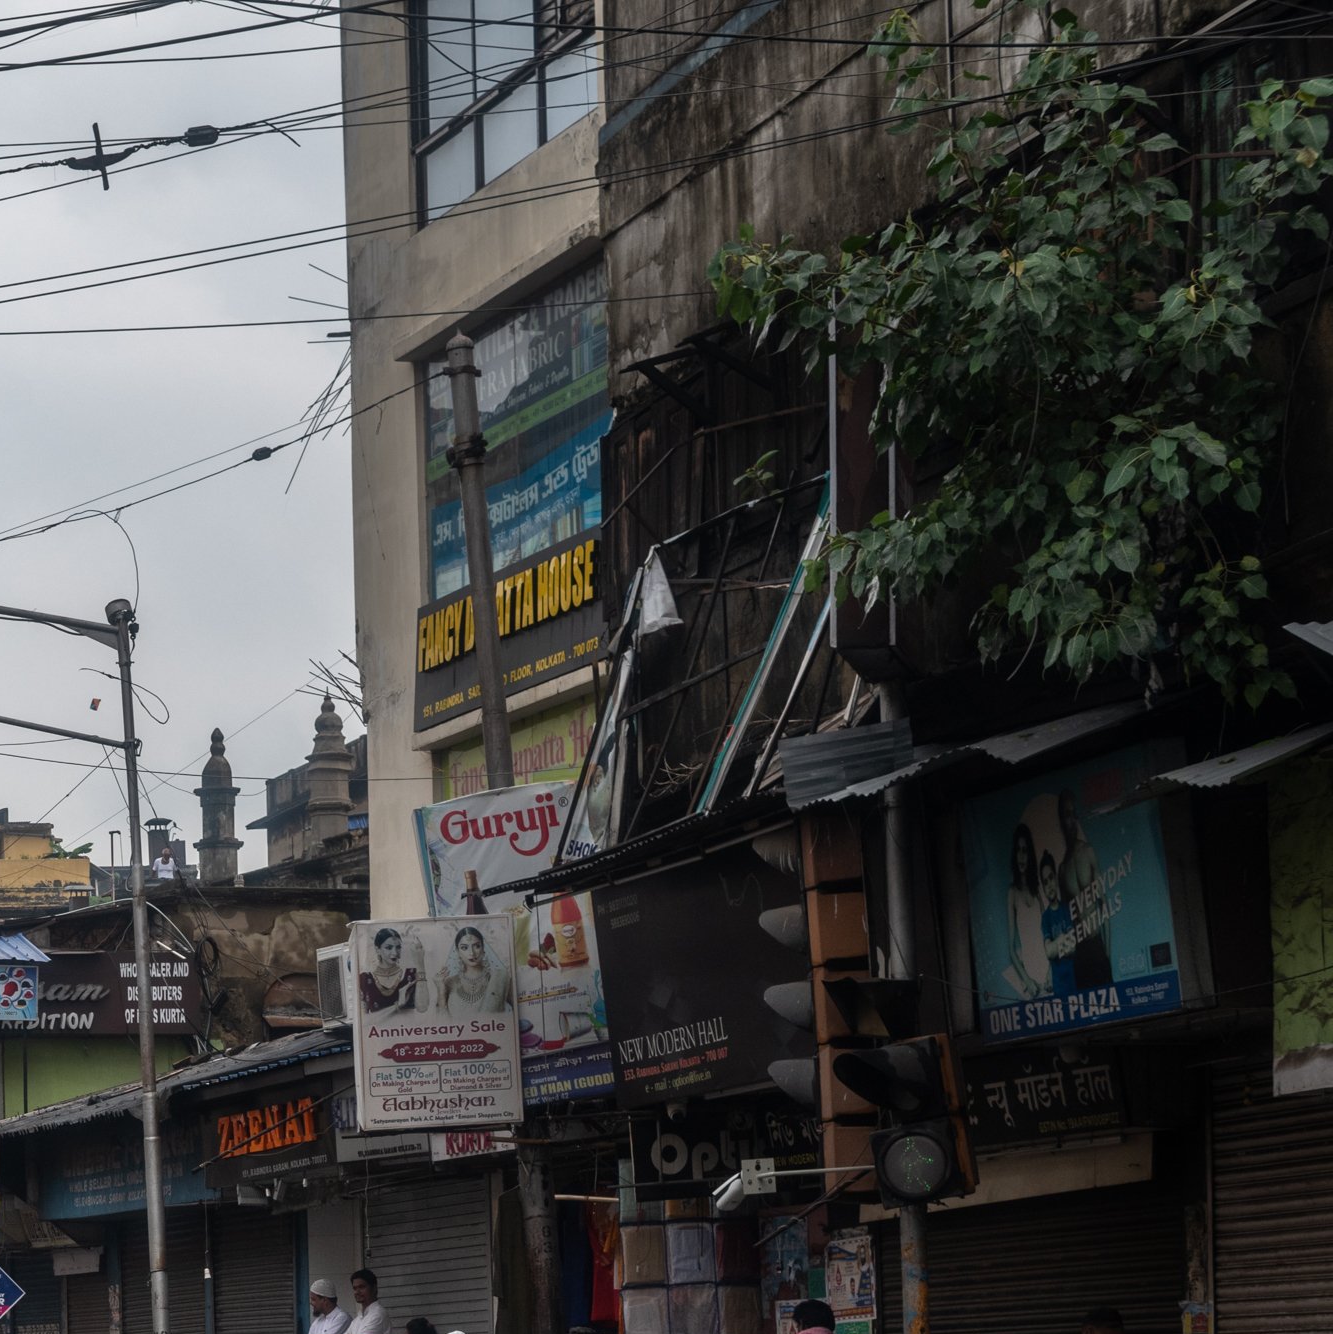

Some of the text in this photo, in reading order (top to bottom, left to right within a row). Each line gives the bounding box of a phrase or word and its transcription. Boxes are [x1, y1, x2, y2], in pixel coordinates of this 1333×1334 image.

[417, 538, 595, 673] FANCY DATTA HOUSE
[422, 636, 599, 719] 151, RABINDRA FLOOR, KOLKATA 700 073
[439, 792, 560, 857] Guruji
[1069, 850, 1133, 921] EVERYDAY
[1058, 892, 1122, 960] ESSENTIALS
[172, 963, 189, 977] AND
[124, 1008, 186, 1024] OF KURTA
[989, 986, 1121, 1035] ONE STAR PLAZA
[368, 1020, 506, 1038] Anniversary Sale
[618, 1036, 645, 1065] NEW
[646, 1024, 697, 1060] MODERN
[697, 1016, 729, 1047] HALL
[432, 1044, 484, 1056] April, 2022
[375, 1067, 423, 1081] Flat 50%
[444, 1063, 497, 1077] Flat 100%
[382, 1080, 405, 1088] Making
[406, 1079, 431, 1087] Charges
[452, 1077, 476, 1085] Making
[477, 1075, 502, 1083] Charges
[539, 1080, 572, 1094] KHAN
[382, 1094, 496, 1113] Aabhushan
[477, 1112, 502, 1120] Shoppers
[217, 1096, 318, 1160] ZEENAT
